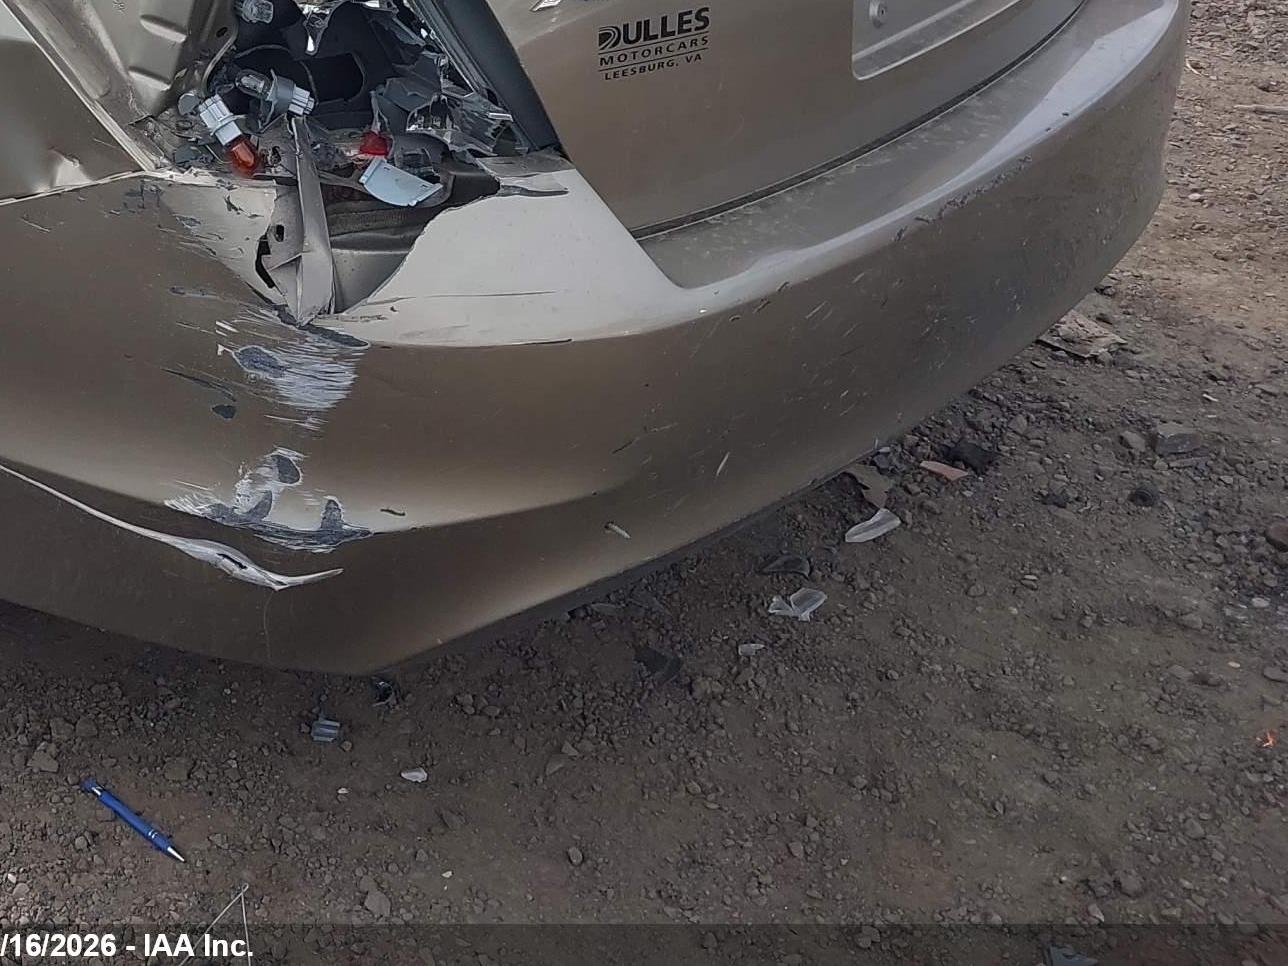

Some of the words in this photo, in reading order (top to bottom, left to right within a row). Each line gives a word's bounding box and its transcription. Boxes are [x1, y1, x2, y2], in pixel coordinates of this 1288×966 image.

[598, 7, 710, 50] DULLES
[599, 35, 709, 66] MOTORCARS
[685, 53, 703, 63] VA
